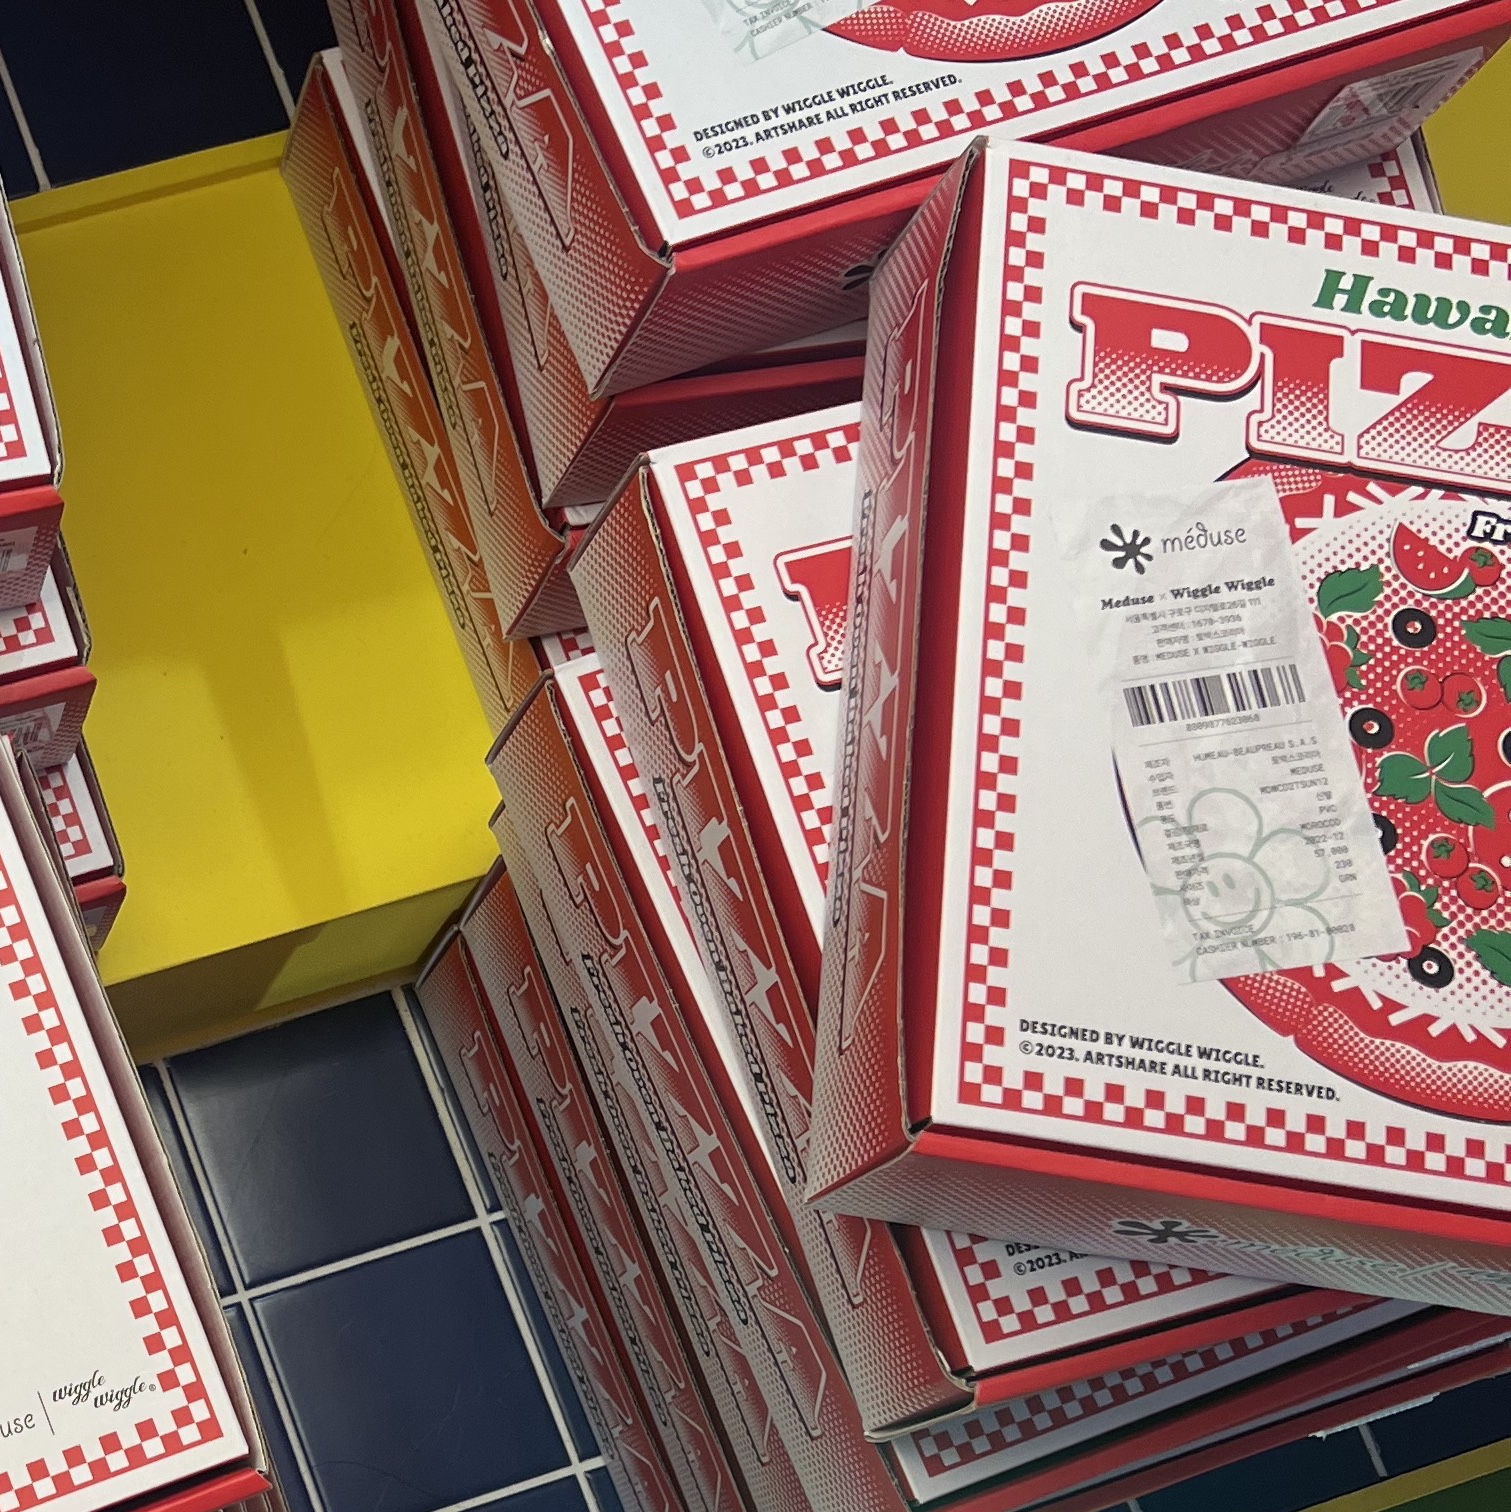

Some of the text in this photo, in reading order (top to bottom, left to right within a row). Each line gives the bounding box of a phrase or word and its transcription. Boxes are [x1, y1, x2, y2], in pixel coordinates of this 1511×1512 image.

[693, 75, 893, 141] DESIGNED BY WIGGLE WIGGLE.
[755, 113, 823, 143] ARTSHARE
[826, 107, 849, 121] ALL
[849, 93, 890, 114] RIGHT
[892, 73, 962, 101] RESERVED.
[1312, 269, 1511, 340] Hawa
[1161, 522, 1246, 553] méduse
[1101, 577, 1275, 610] Meduse Wiggle Wiggle
[842, 279, 928, 1056] PIZZA
[1020, 1019, 1264, 1068] DESIGNED BY WIGGLE WIGGLE.
[1083, 1051, 1167, 1075] ARTSHARE
[1171, 1064, 1198, 1080] ALL
[1202, 1068, 1252, 1088] RIGHT
[1256, 1077, 1339, 1101] RESERVED.
[546, 798, 824, 1437] PIZZA
[52, 1369, 106, 1406] wiggle
